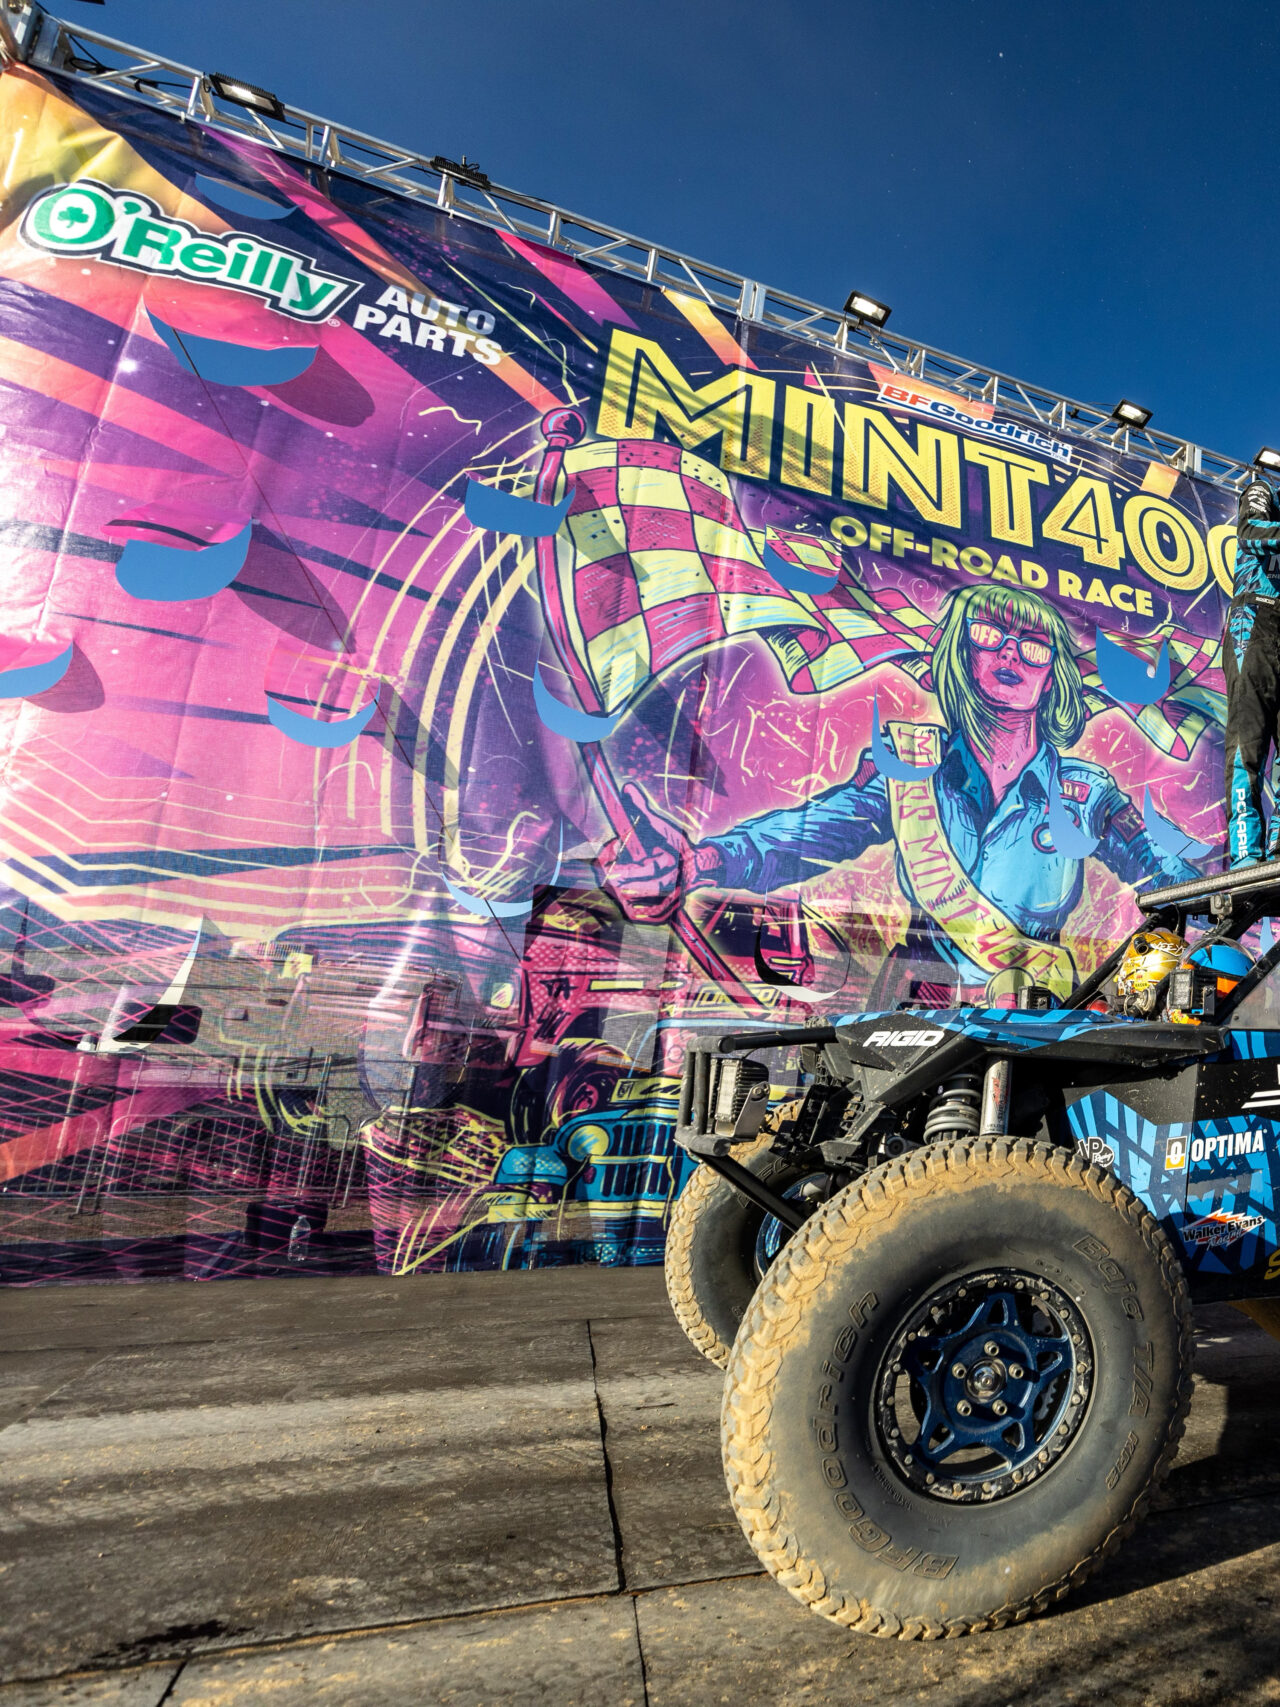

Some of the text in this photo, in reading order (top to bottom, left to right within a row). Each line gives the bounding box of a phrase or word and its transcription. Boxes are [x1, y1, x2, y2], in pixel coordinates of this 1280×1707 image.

[30, 185, 337, 312] O'Reilly
[353, 303, 503, 366] PARTS
[375, 284, 496, 336] AUTO
[881, 385, 1071, 457] BFGoodrich
[830, 515, 1155, 617] OFF-ROAD RACE
[969, 621, 1052, 665] OFF ROAD
[903, 830, 992, 925] MINT
[862, 1029, 946, 1048] RIGID
[1191, 1129, 1265, 1162] OPTIMA
[1183, 1214, 1264, 1242] Walker Evans
[1072, 1234, 1144, 1322] Baja
[815, 1290, 960, 1581] BFGoodrich
